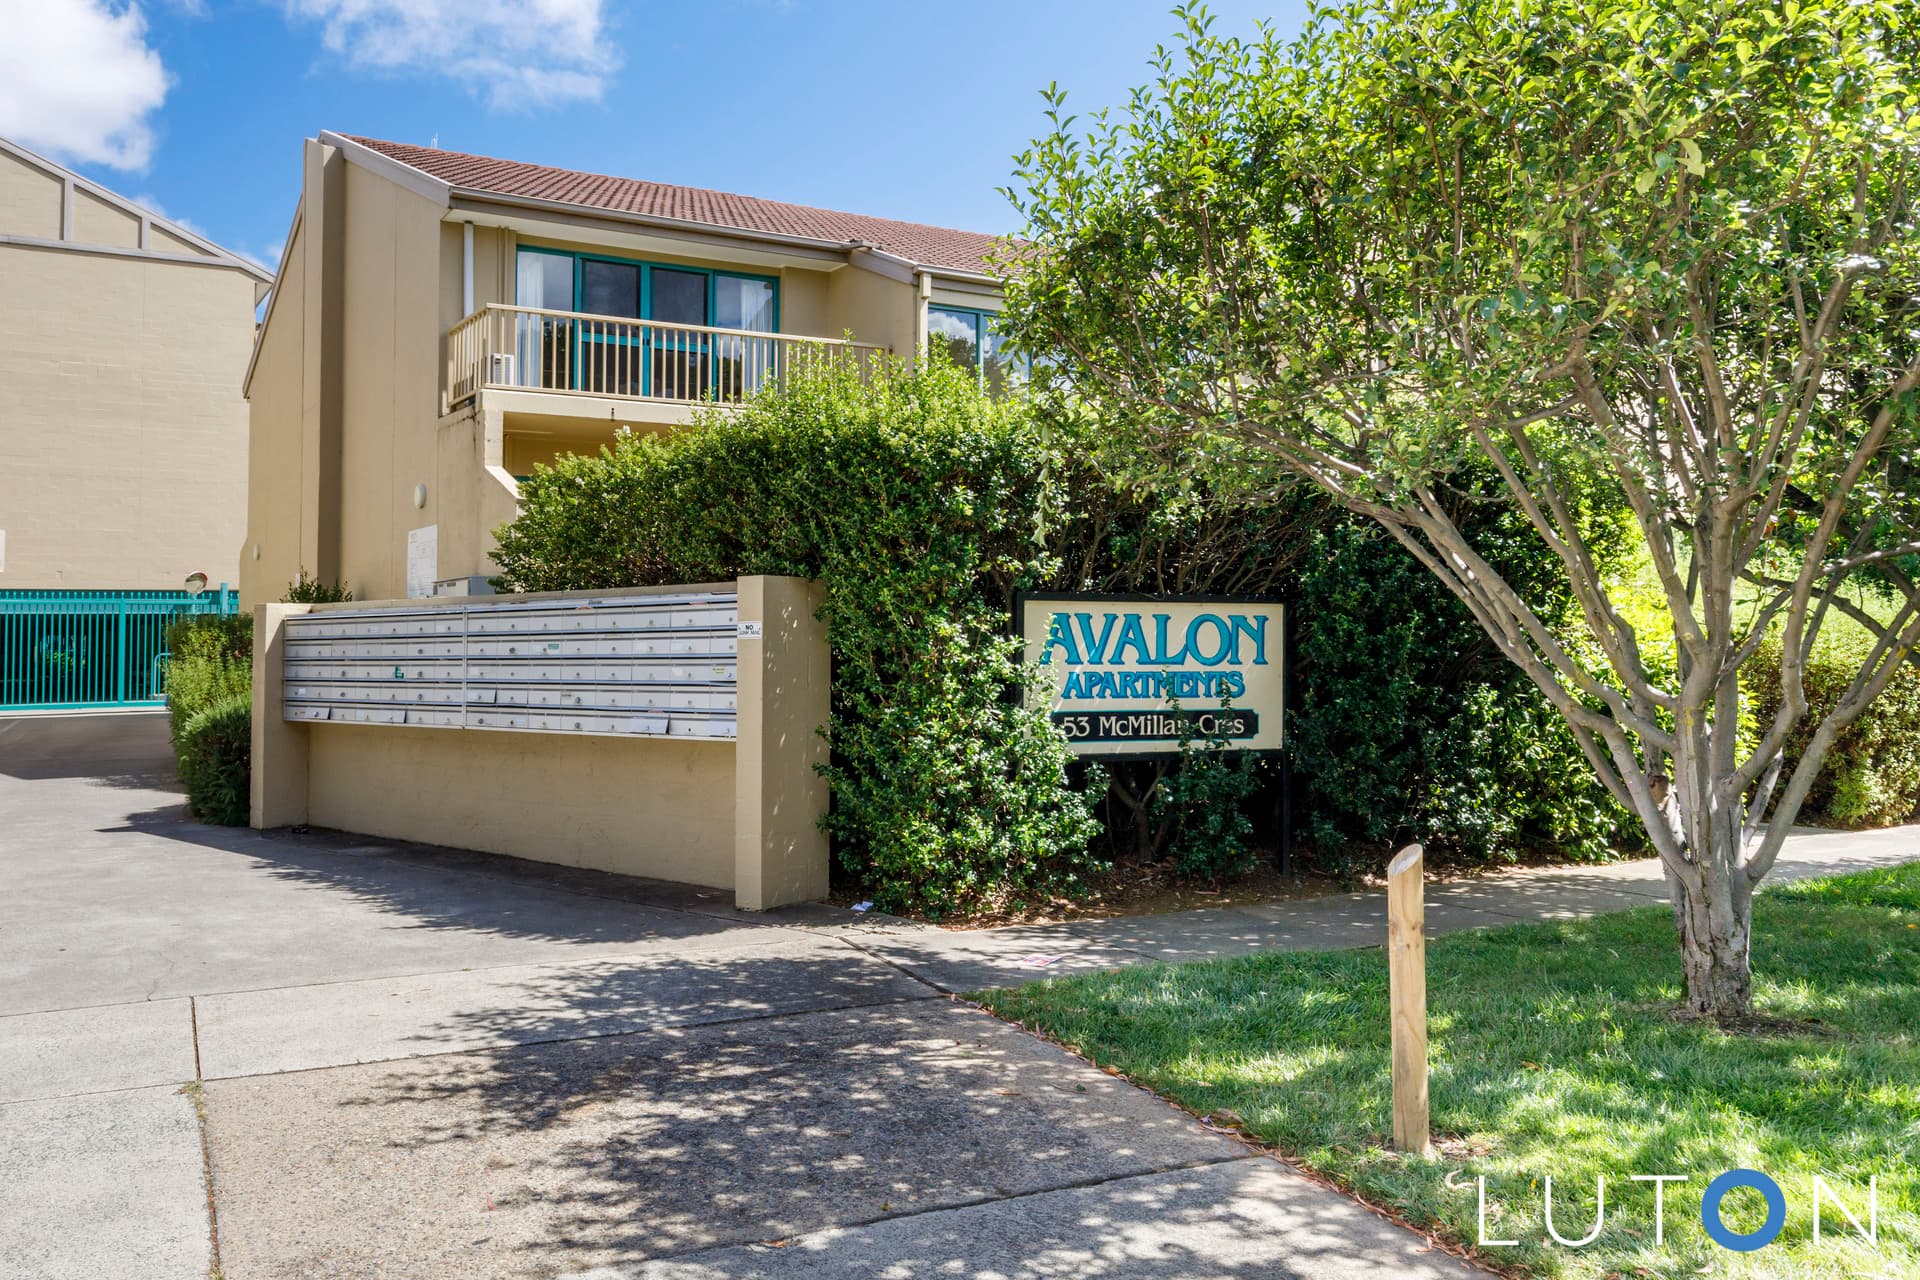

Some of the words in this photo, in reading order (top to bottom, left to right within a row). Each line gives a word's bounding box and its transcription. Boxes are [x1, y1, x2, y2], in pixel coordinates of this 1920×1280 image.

[1040, 612, 1269, 667] AVALON
[1062, 671, 1246, 699] APARTMENTS
[1063, 716, 1090, 737] 53
